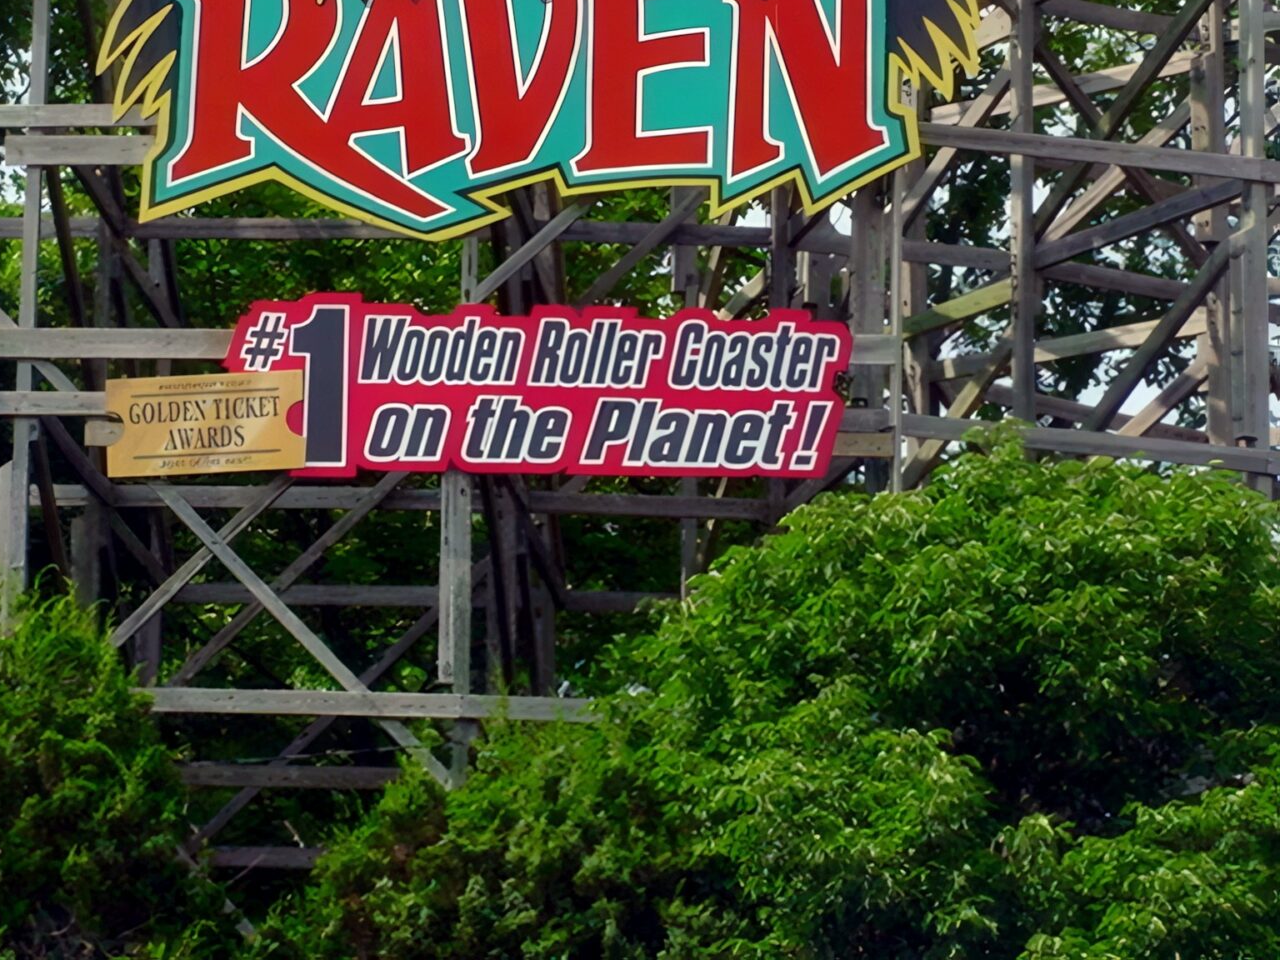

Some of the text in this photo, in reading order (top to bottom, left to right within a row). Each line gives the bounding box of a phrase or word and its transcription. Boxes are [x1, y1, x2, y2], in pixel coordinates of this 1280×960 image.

[129, 395, 280, 425] GOLDEN TICKET
[240, 304, 839, 467] #1 Wooden Roller Coaster
[164, 425, 246, 452] AWARDS
[364, 395, 834, 471] on the Planet!
